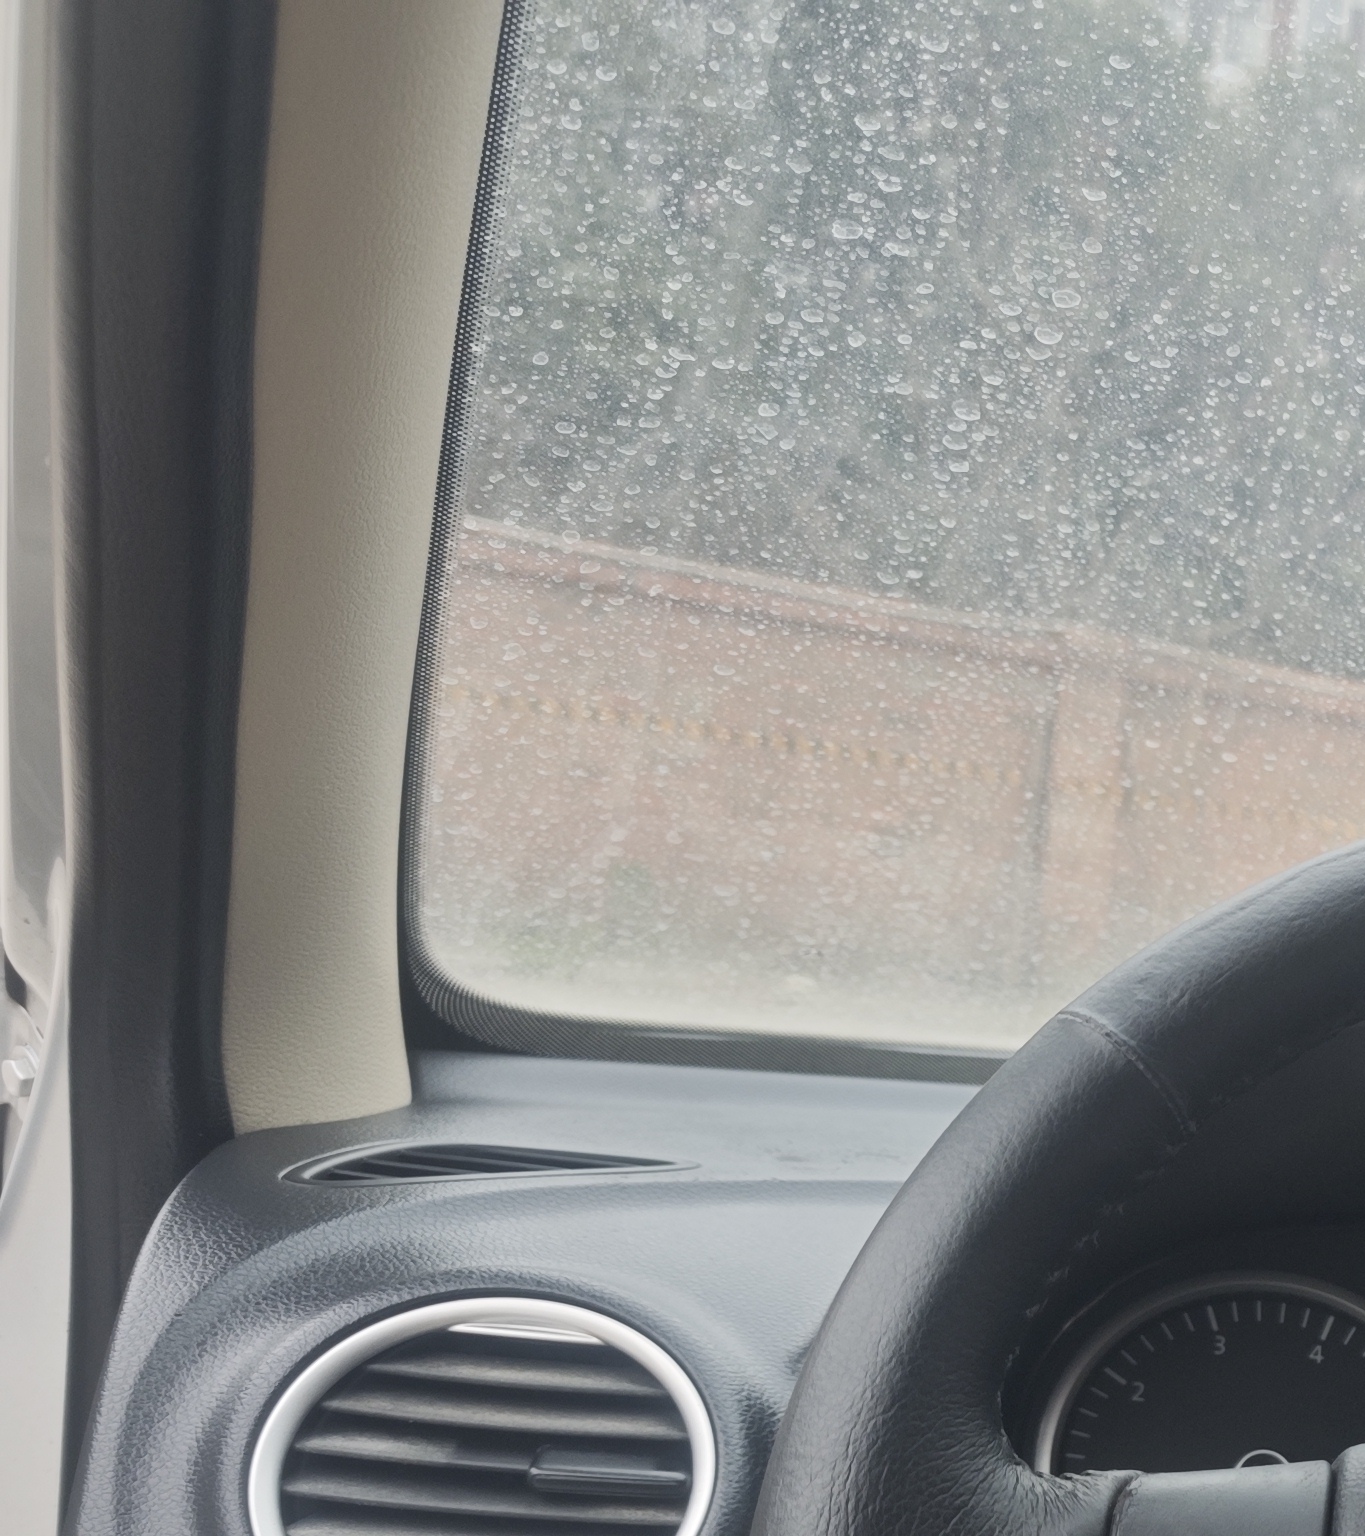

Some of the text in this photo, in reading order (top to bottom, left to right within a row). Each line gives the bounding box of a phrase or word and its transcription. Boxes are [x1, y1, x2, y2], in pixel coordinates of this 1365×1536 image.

[1213, 1336, 1226, 1355] 3
[1309, 1344, 1325, 1364] 4
[1132, 1382, 1146, 1401] 2
